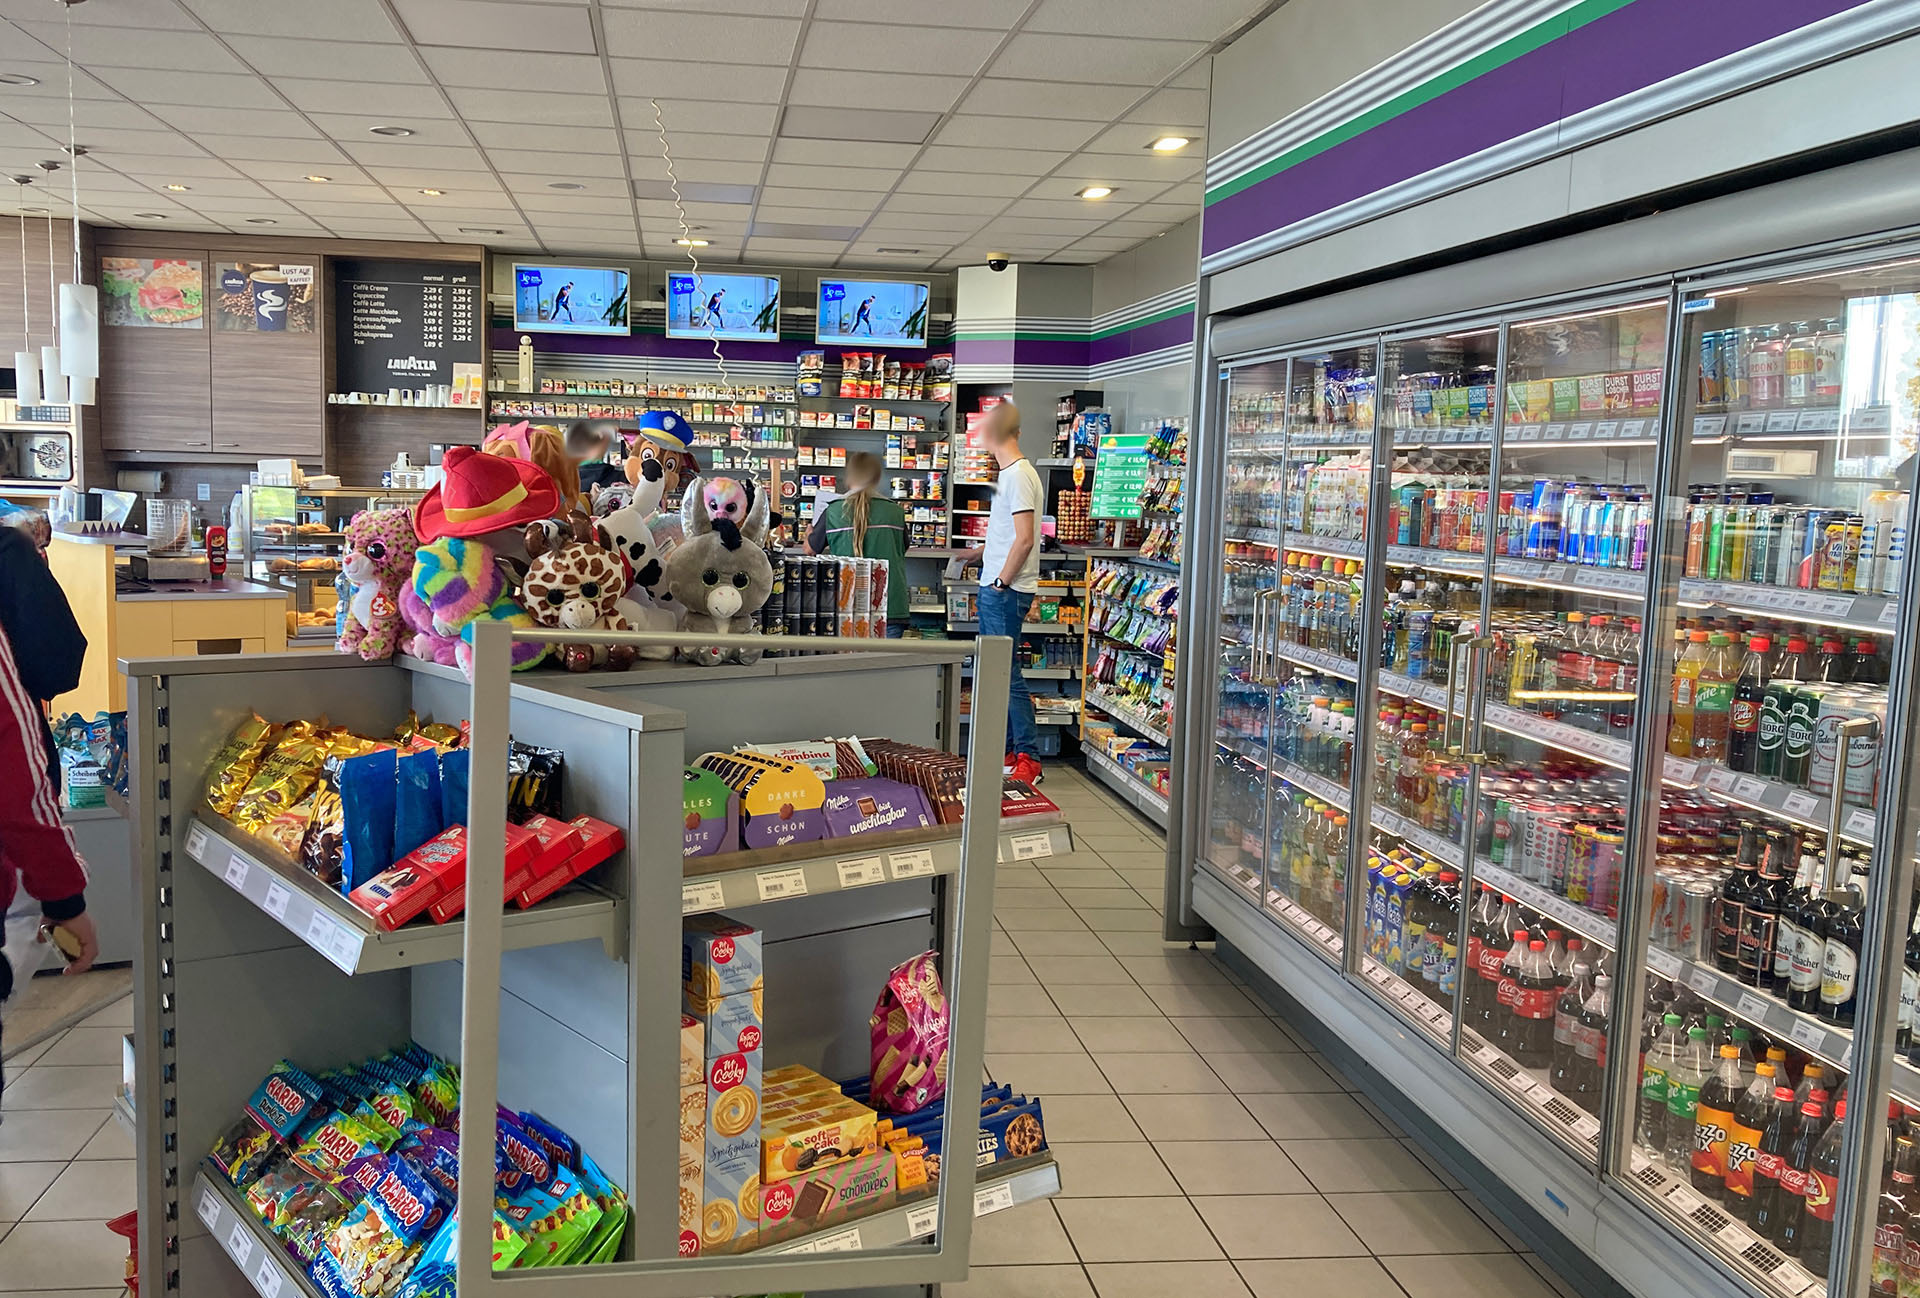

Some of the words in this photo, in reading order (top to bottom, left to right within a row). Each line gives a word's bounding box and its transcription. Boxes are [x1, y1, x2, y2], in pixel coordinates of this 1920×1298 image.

[353, 323, 386, 331] Schokolade
[387, 356, 437, 371] LAVAZZA
[1605, 376, 1628, 387] DURST
[1633, 372, 1661, 384] DURST
[774, 751, 831, 762] ambina
[768, 789, 806, 802] DANKE
[826, 795, 850, 809] Milka
[683, 798, 712, 809] LLES
[879, 801, 891, 811] bist
[767, 821, 805, 834] SCHÖN
[849, 807, 907, 835] unschlagbar
[685, 831, 709, 843] UTE
[777, 835, 795, 846] Milka
[1525, 816, 1536, 857] effect
[683, 845, 702, 857] Milka
[712, 946, 734, 958] Cooky
[713, 1065, 744, 1084] Cooky
[266, 1076, 306, 1116] HARIBO
[804, 1130, 826, 1146] soft
[1696, 1123, 1727, 1142] ezzo
[315, 1124, 360, 1162] HARIB
[814, 1136, 840, 1150] cake
[353, 1162, 380, 1191] HAR
[377, 1171, 424, 1227] HARIBO
[766, 1196, 793, 1212] Cooky
